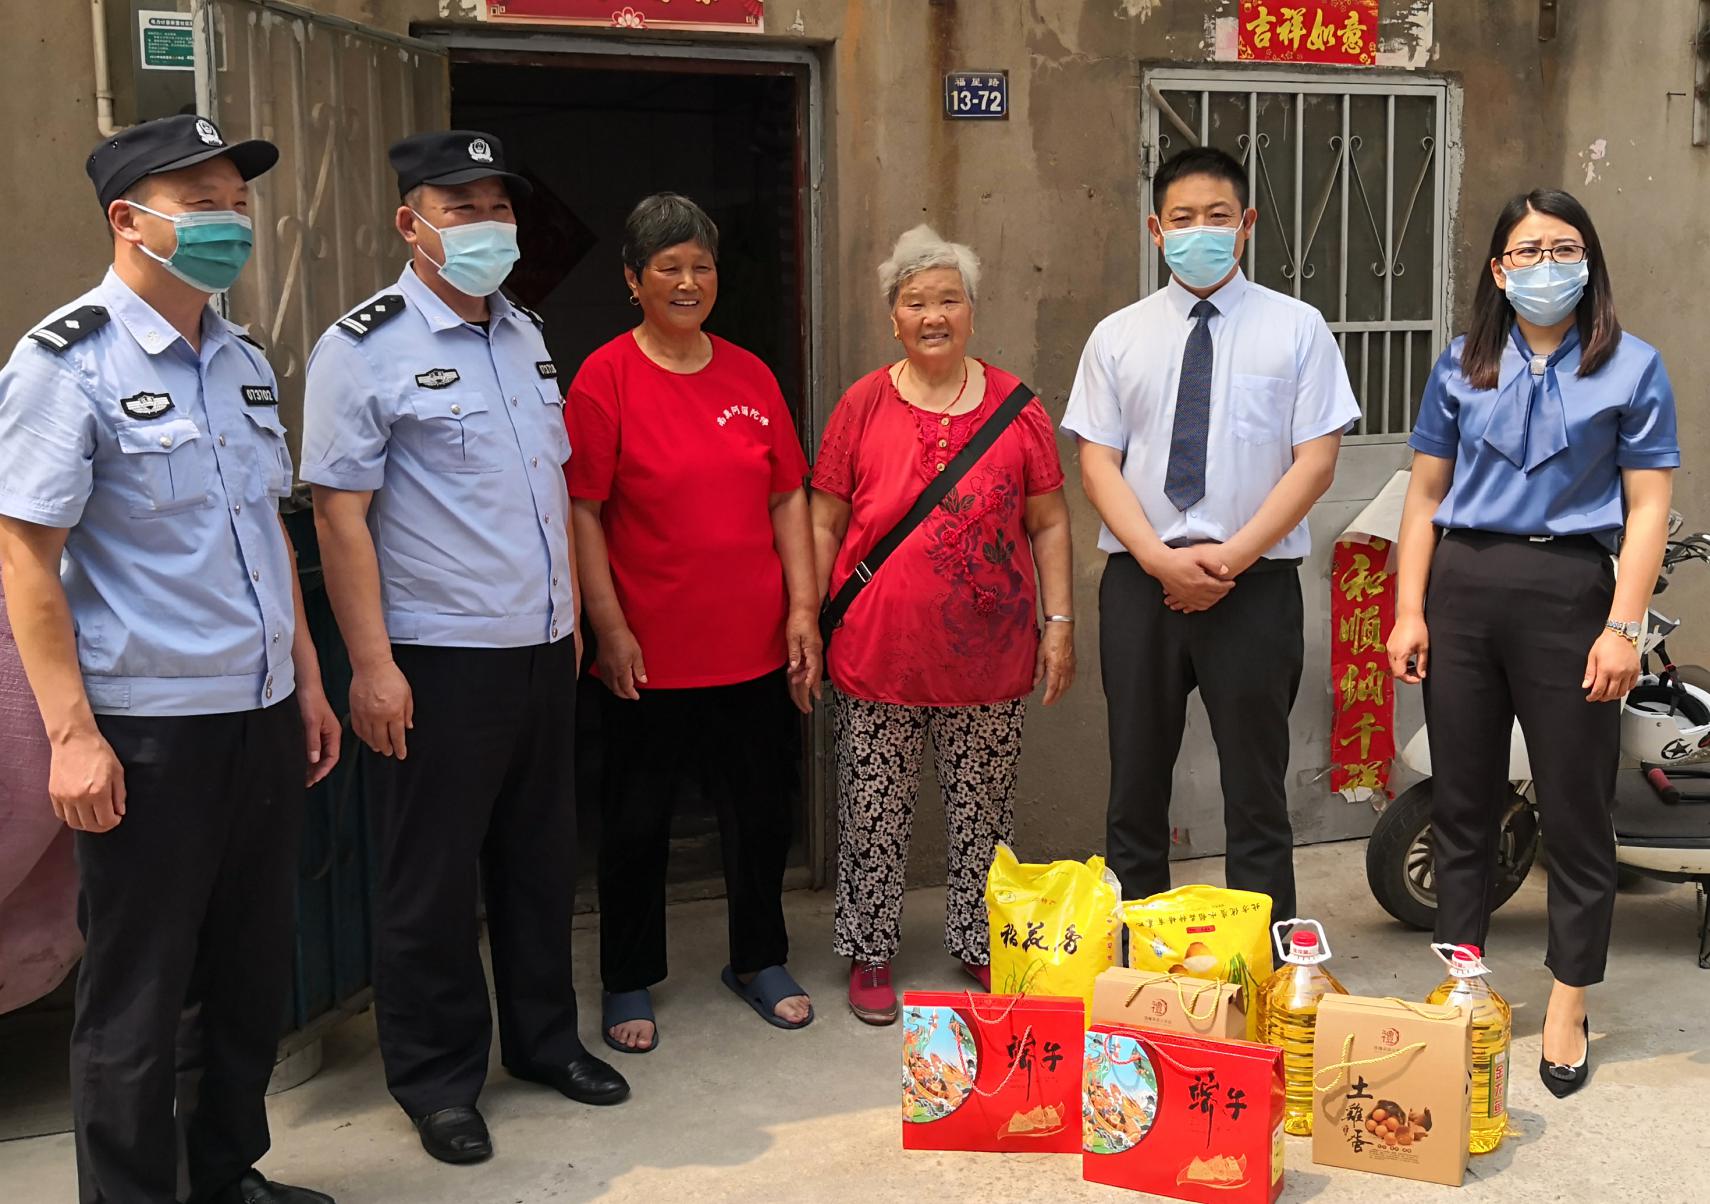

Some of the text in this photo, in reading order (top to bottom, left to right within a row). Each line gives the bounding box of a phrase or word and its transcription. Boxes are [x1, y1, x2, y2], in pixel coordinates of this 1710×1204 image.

[1246, 6, 1367, 54] 吉祥如意
[951, 91, 1002, 111] 13-72
[1339, 540, 1388, 790] 和順納千祥
[1000, 921, 1083, 955] 稻花香
[1188, 1071, 1248, 1149] 端午
